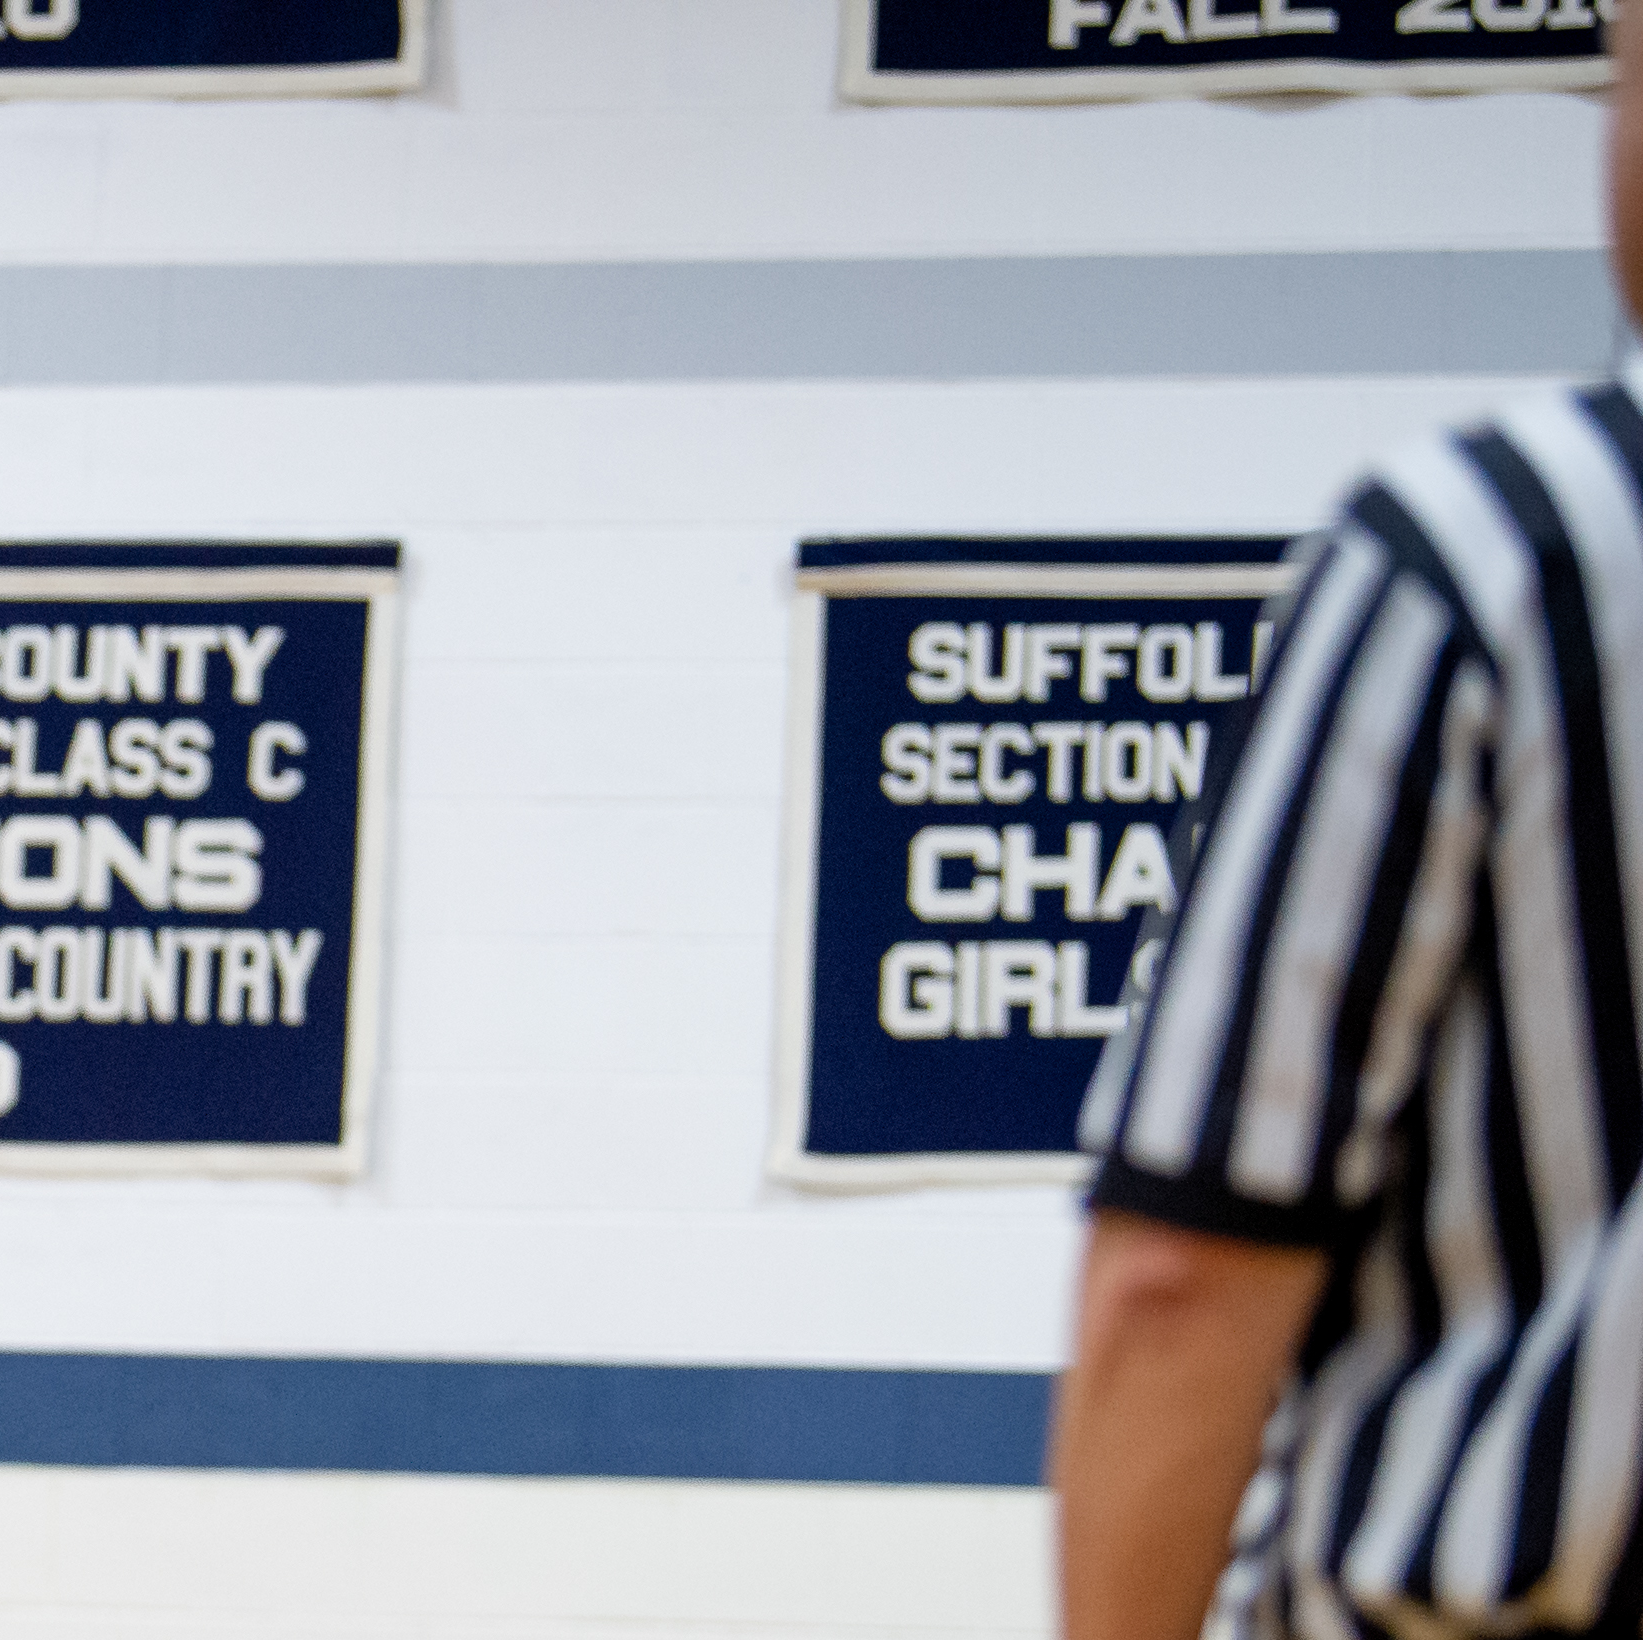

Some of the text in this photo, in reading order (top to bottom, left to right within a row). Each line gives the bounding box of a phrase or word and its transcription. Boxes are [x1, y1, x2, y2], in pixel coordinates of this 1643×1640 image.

[1048, 0, 1337, 49] FALL
[247, 720, 308, 802] C
[879, 719, 1211, 804] SECTION
